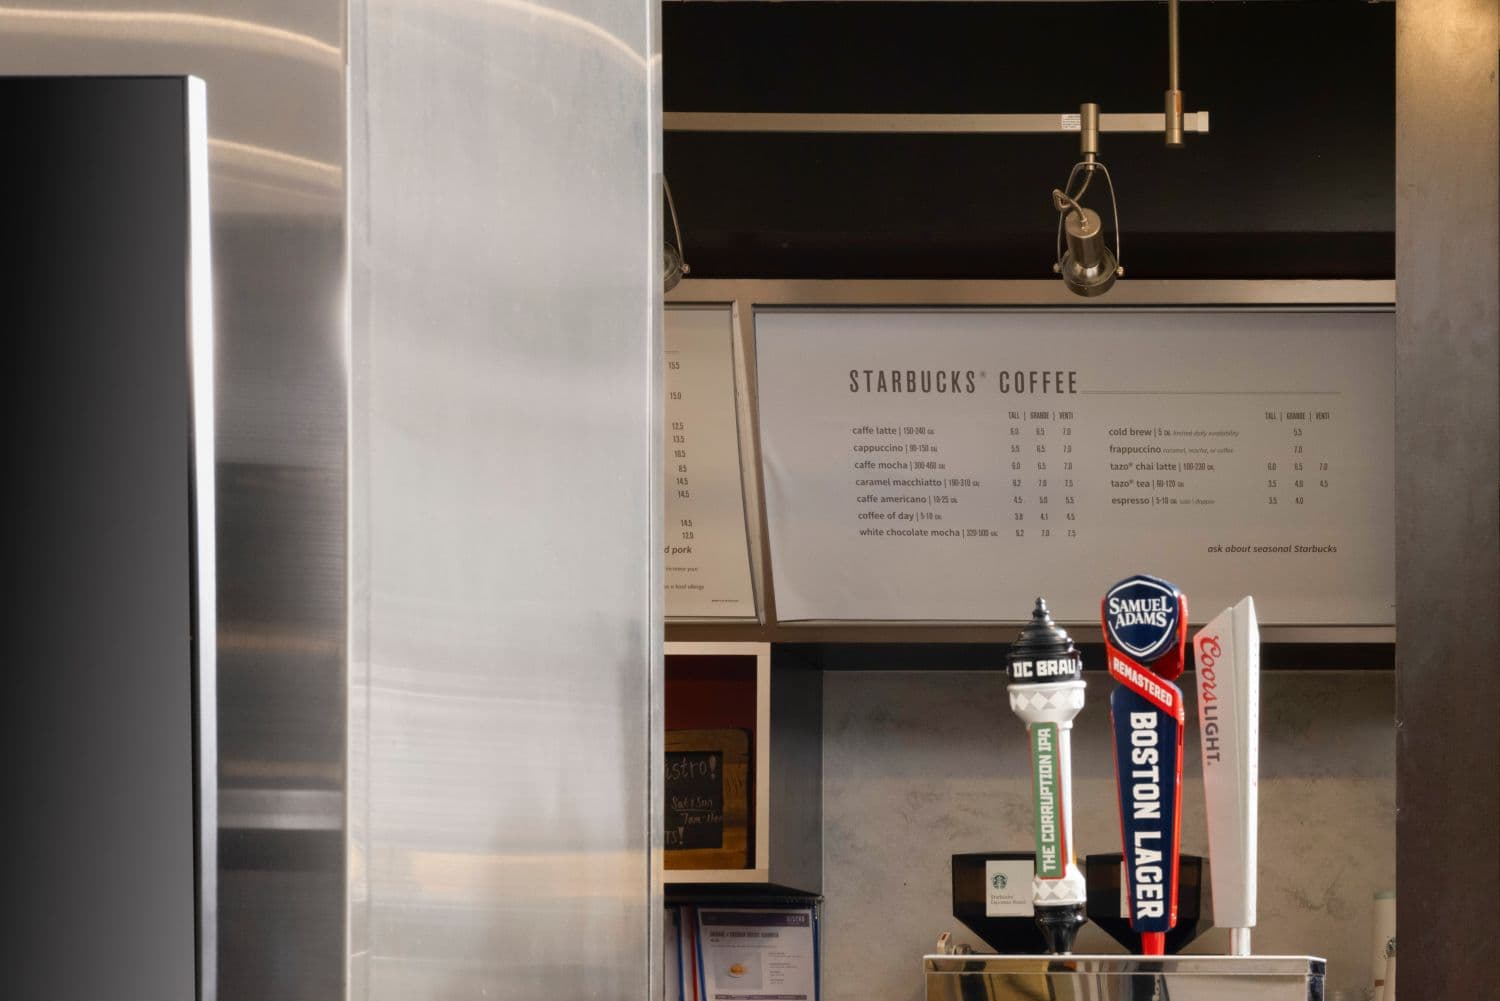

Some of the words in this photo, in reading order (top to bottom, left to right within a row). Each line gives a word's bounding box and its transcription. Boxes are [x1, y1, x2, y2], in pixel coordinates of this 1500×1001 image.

[999, 370, 1077, 394] COFFEE
[852, 426, 874, 435] caffe
[876, 426, 897, 435] latte
[1108, 428, 1127, 436] cold
[1129, 428, 1152, 436] brew
[853, 444, 903, 453] cappuccino
[1109, 445, 1161, 455] frappuccino
[854, 460, 876, 469] caffe
[878, 460, 908, 469] mocha
[1135, 462, 1154, 471] chai
[1156, 462, 1177, 471] latte
[855, 478, 891, 487] caramel
[893, 478, 942, 487] macchiatto
[856, 495, 878, 503] caffe
[880, 495, 927, 503] americano
[1111, 497, 1150, 506] espresso
[858, 511, 884, 520] coffee
[886, 511, 896, 520] of
[898, 511, 914, 522] day
[859, 528, 884, 537] white
[886, 528, 929, 537] chocolate
[931, 528, 960, 537] mocha
[672, 546, 692, 555] pork
[1207, 545, 1223, 553] ask
[1225, 545, 1251, 553] about
[1252, 545, 1291, 553] seasonal
[1294, 545, 1337, 553] Starbucks
[1109, 596, 1173, 615] SAMUEL
[1115, 611, 1167, 629] ADAMS
[1013, 661, 1033, 678] DC
[1036, 660, 1076, 677] BRAU
[1197, 634, 1222, 703] Coors
[1113, 658, 1174, 708] REMASTERED
[1038, 728, 1051, 750] IPA
[665, 755, 717, 780] istro!
[1130, 712, 1161, 819] BOSTON
[1040, 754, 1056, 842] CORRUPTION
[1042, 845, 1056, 872] THE
[1133, 830, 1163, 920] LAGER
